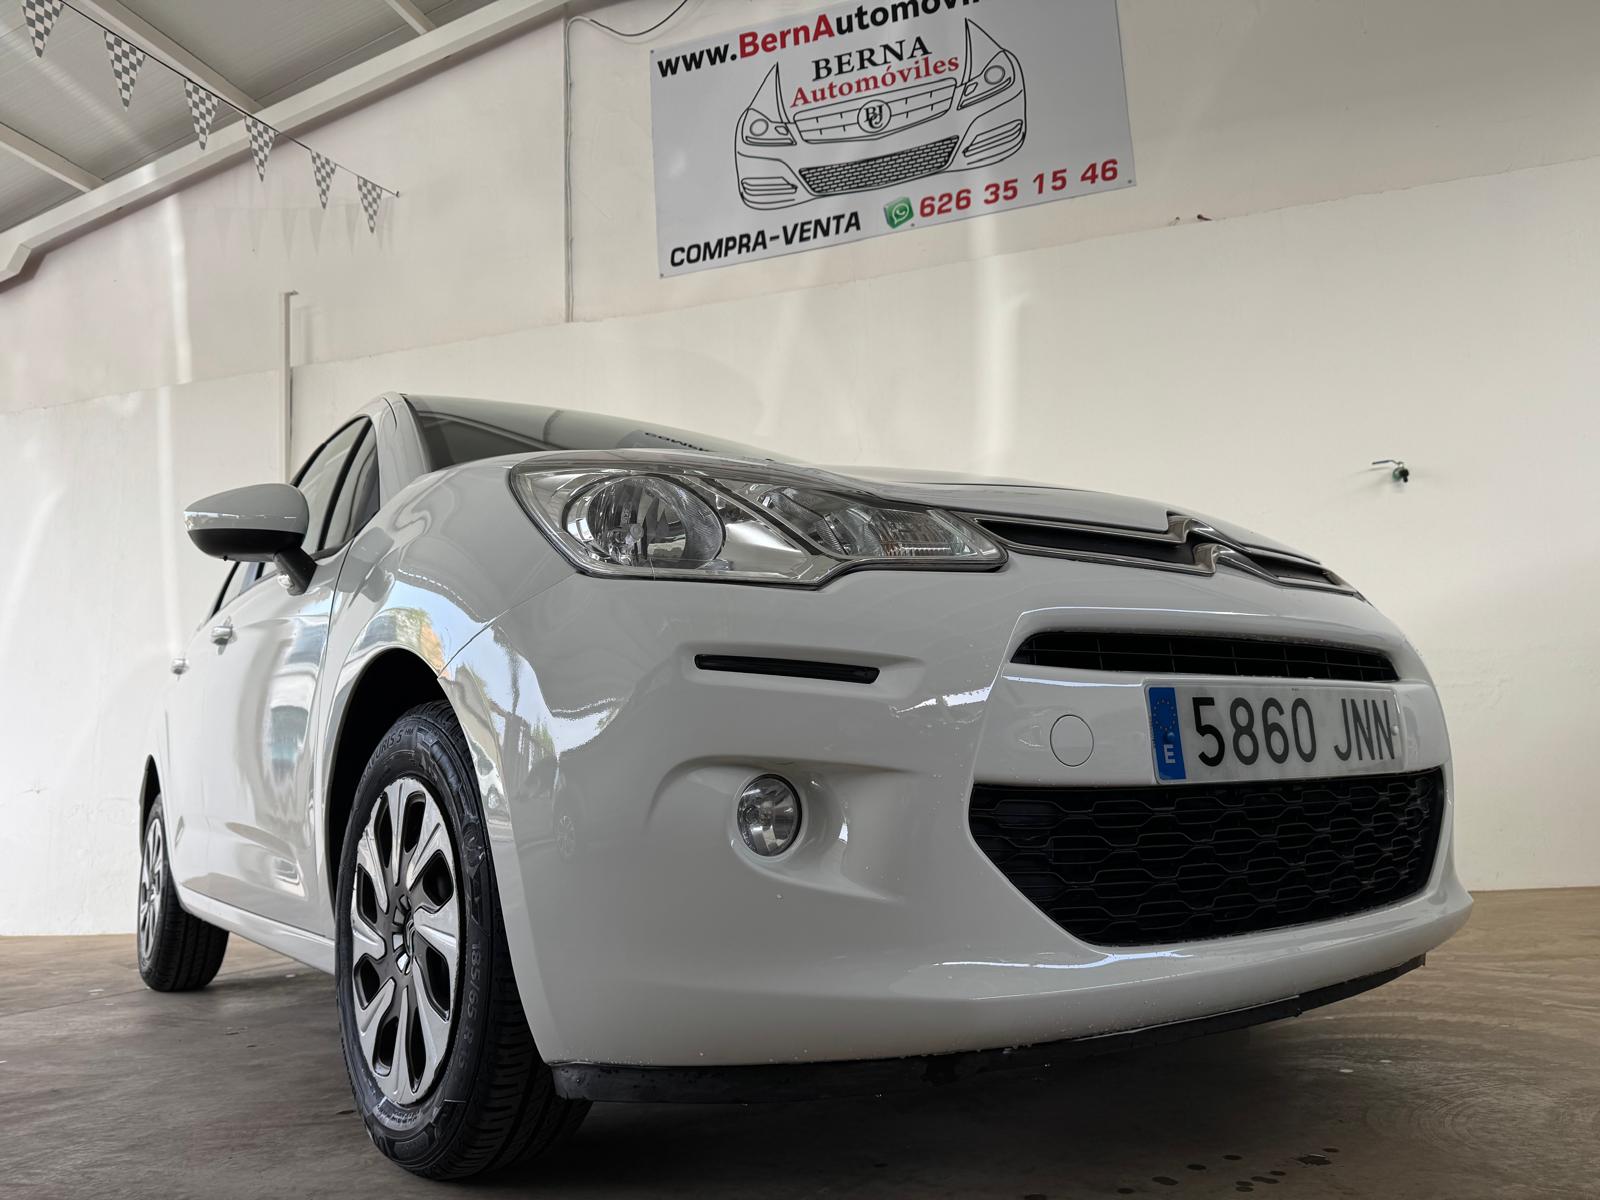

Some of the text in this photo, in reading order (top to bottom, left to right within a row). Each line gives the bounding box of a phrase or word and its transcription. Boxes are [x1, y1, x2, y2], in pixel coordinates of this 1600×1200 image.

[790, 56, 960, 108] Automóviles
[811, 36, 932, 81] BERNA
[919, 158, 1119, 218] 626 35 15 46
[670, 212, 861, 267] COMPRA-VENTA
[1163, 744, 1176, 764] E
[1192, 697, 1395, 767] 5860 JNN
[467, 943, 482, 1020] 185/65
